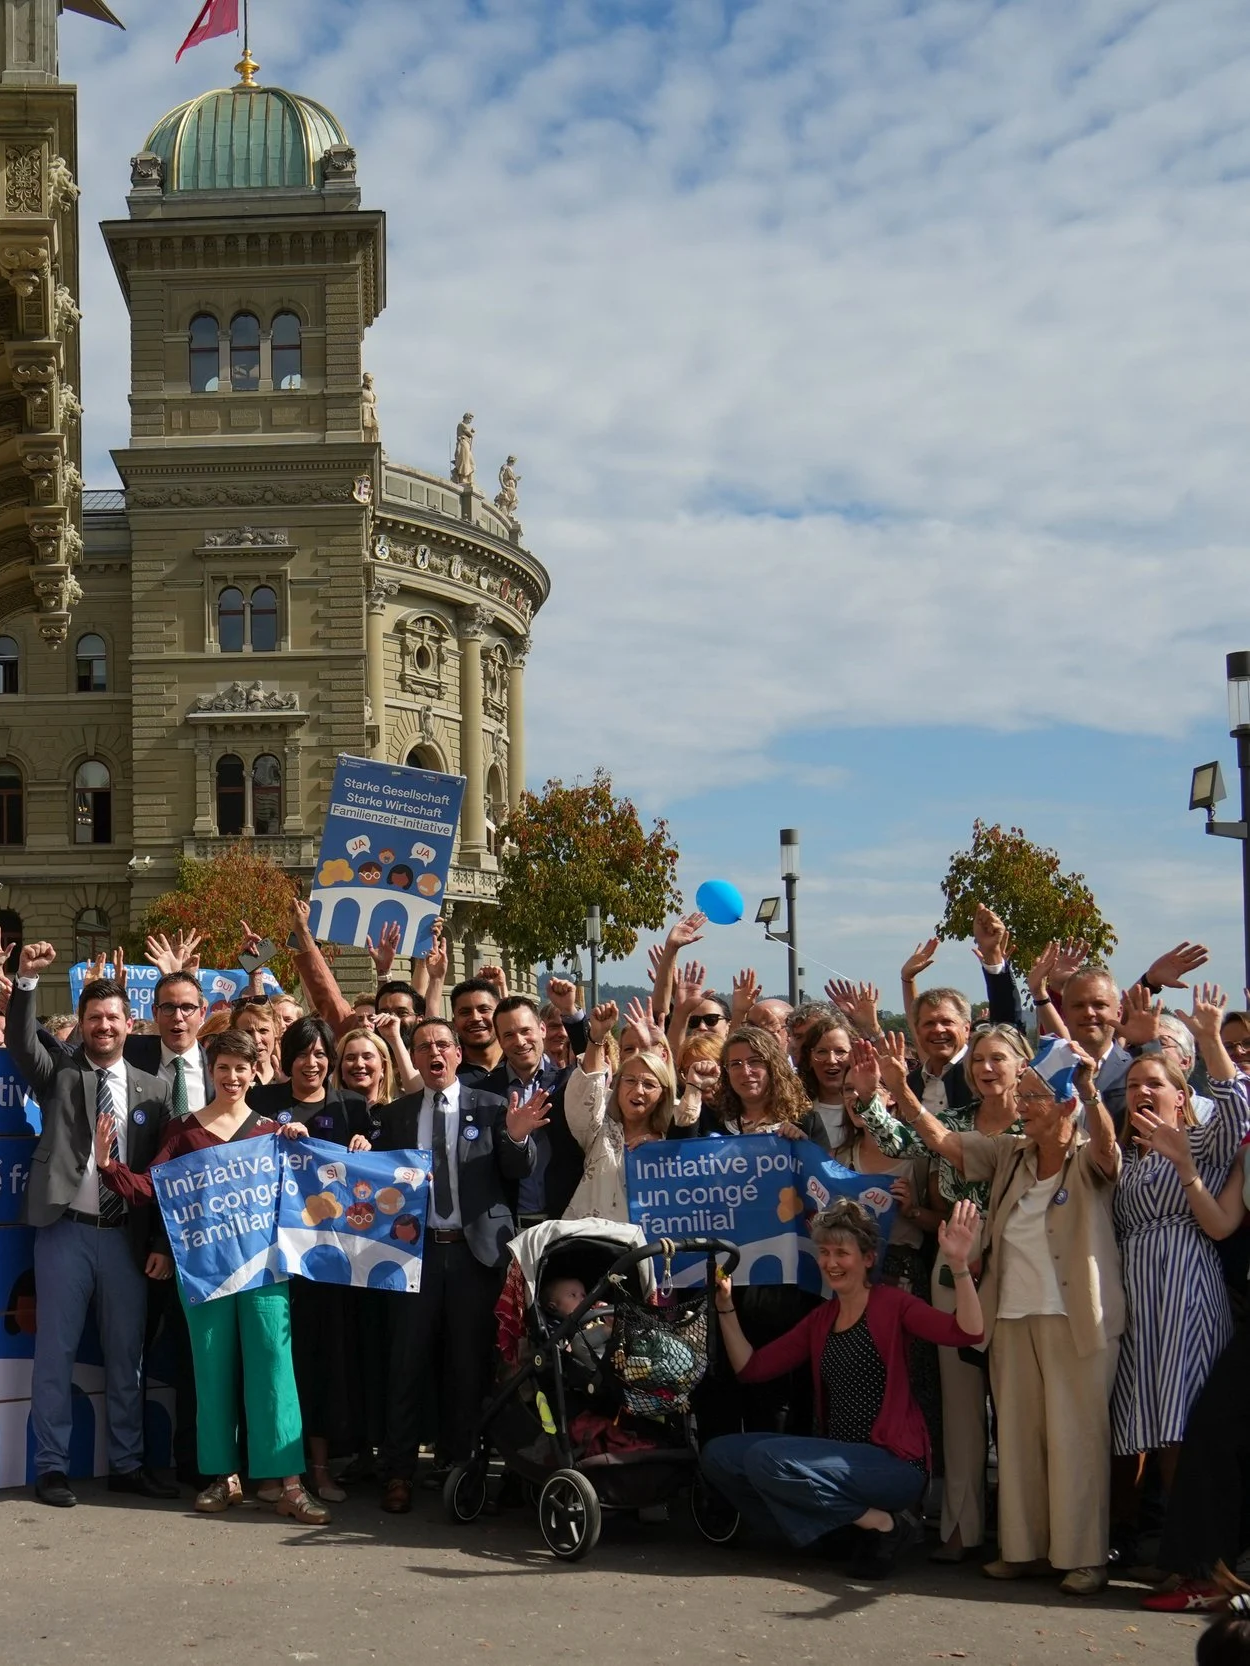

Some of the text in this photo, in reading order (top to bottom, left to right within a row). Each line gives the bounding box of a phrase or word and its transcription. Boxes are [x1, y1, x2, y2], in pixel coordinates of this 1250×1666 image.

[343, 777, 451, 806] Starke Gesellschaft
[346, 792, 442, 818] Starke Wirtschaft
[352, 838, 366, 851] JA
[416, 848, 430, 859] JA
[216, 979, 232, 992] OUI
[164, 1154, 277, 1200] Iniziativa
[636, 1153, 804, 1180] Initiative pour
[638, 1175, 759, 1208] un congé
[809, 1180, 827, 1202] OUI
[864, 1190, 888, 1207] OUI
[172, 1200, 204, 1225] un
[639, 1208, 736, 1234] familial
